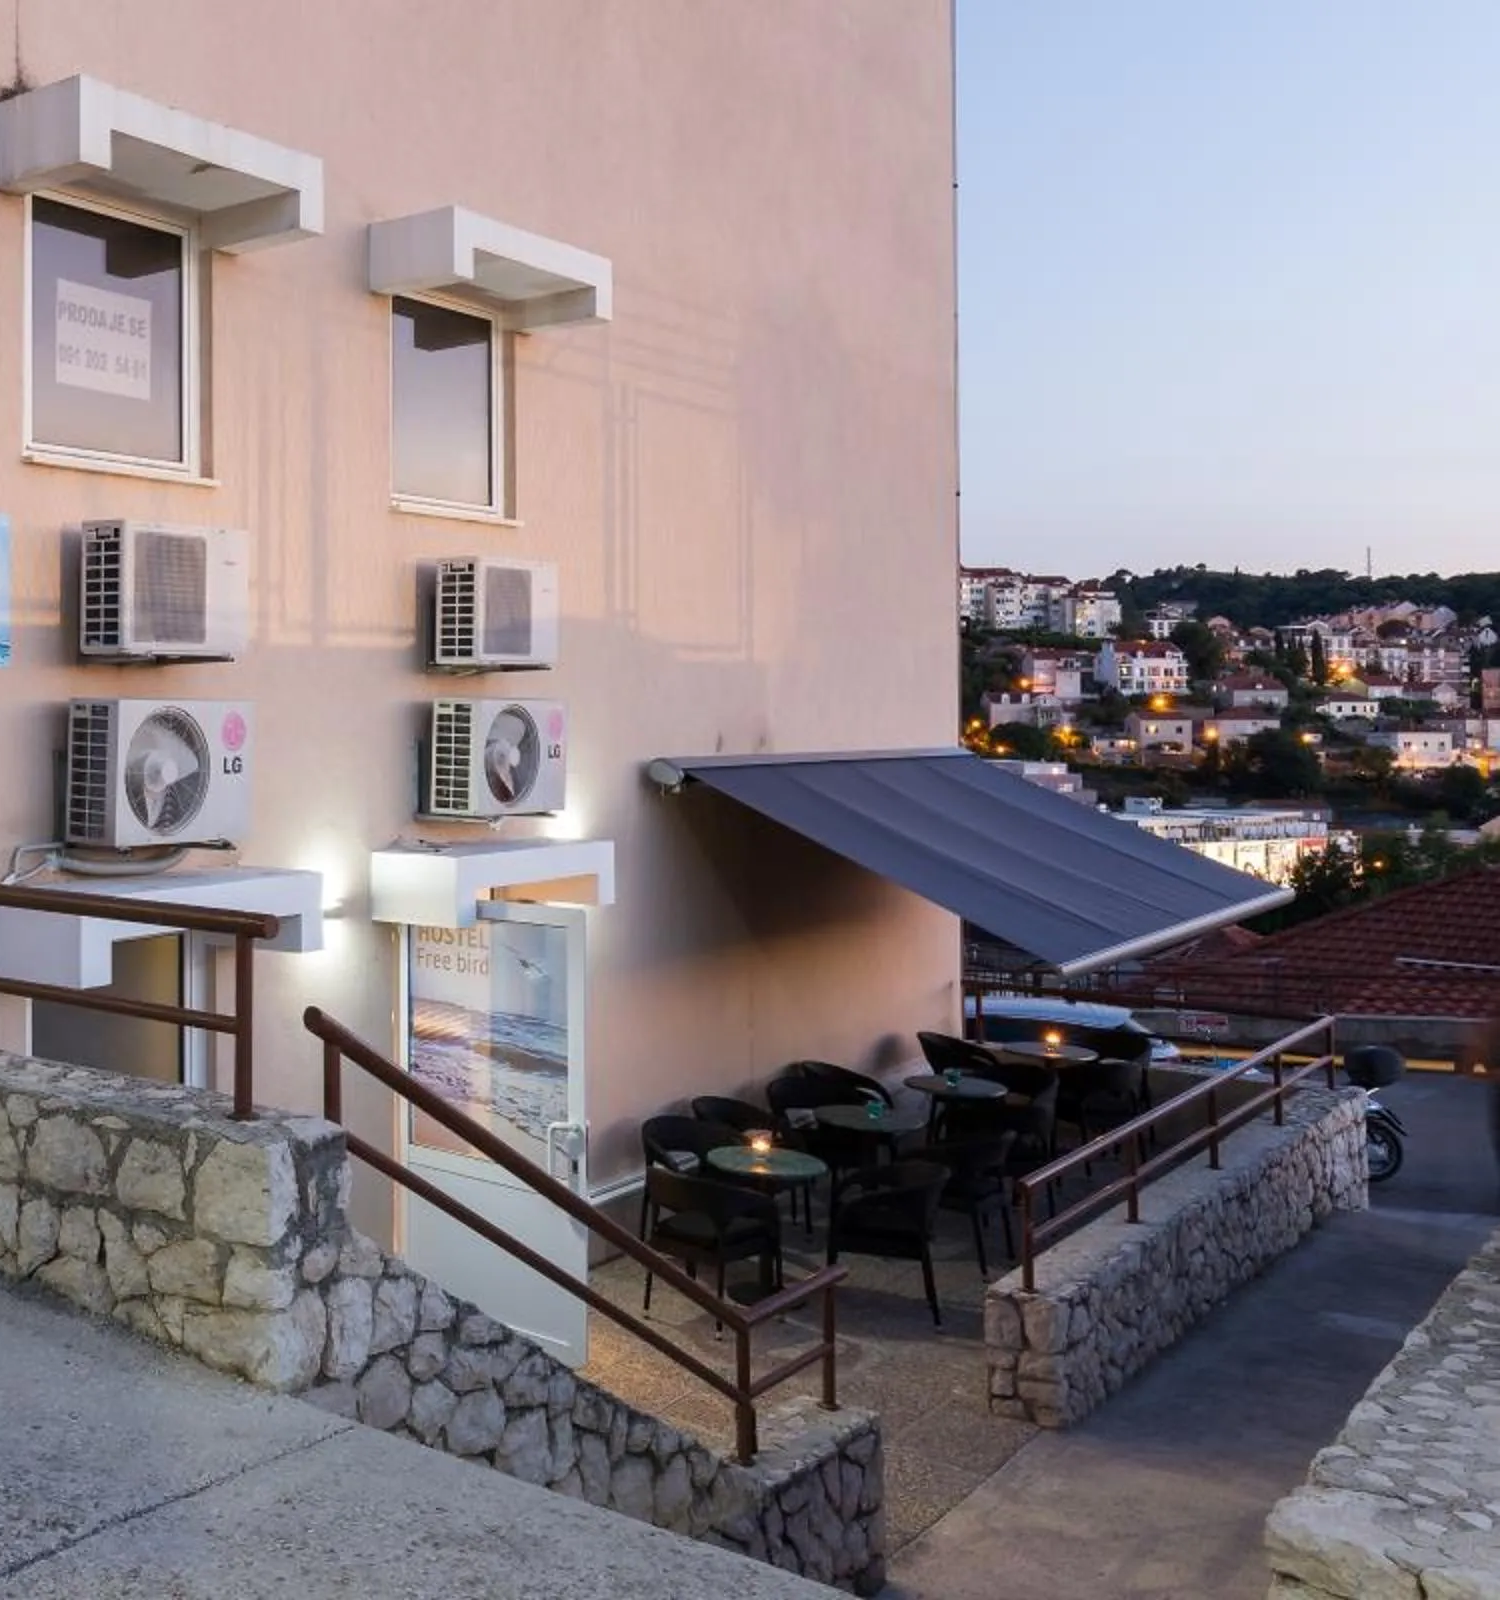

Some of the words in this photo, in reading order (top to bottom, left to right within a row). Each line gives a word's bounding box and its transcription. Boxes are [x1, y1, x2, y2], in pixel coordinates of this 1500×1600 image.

[547, 744, 561, 759] LG
[223, 756, 242, 774] LG
[418, 926, 489, 951] HOSTEL
[417, 947, 453, 971] Free
[457, 951, 489, 976] bird
